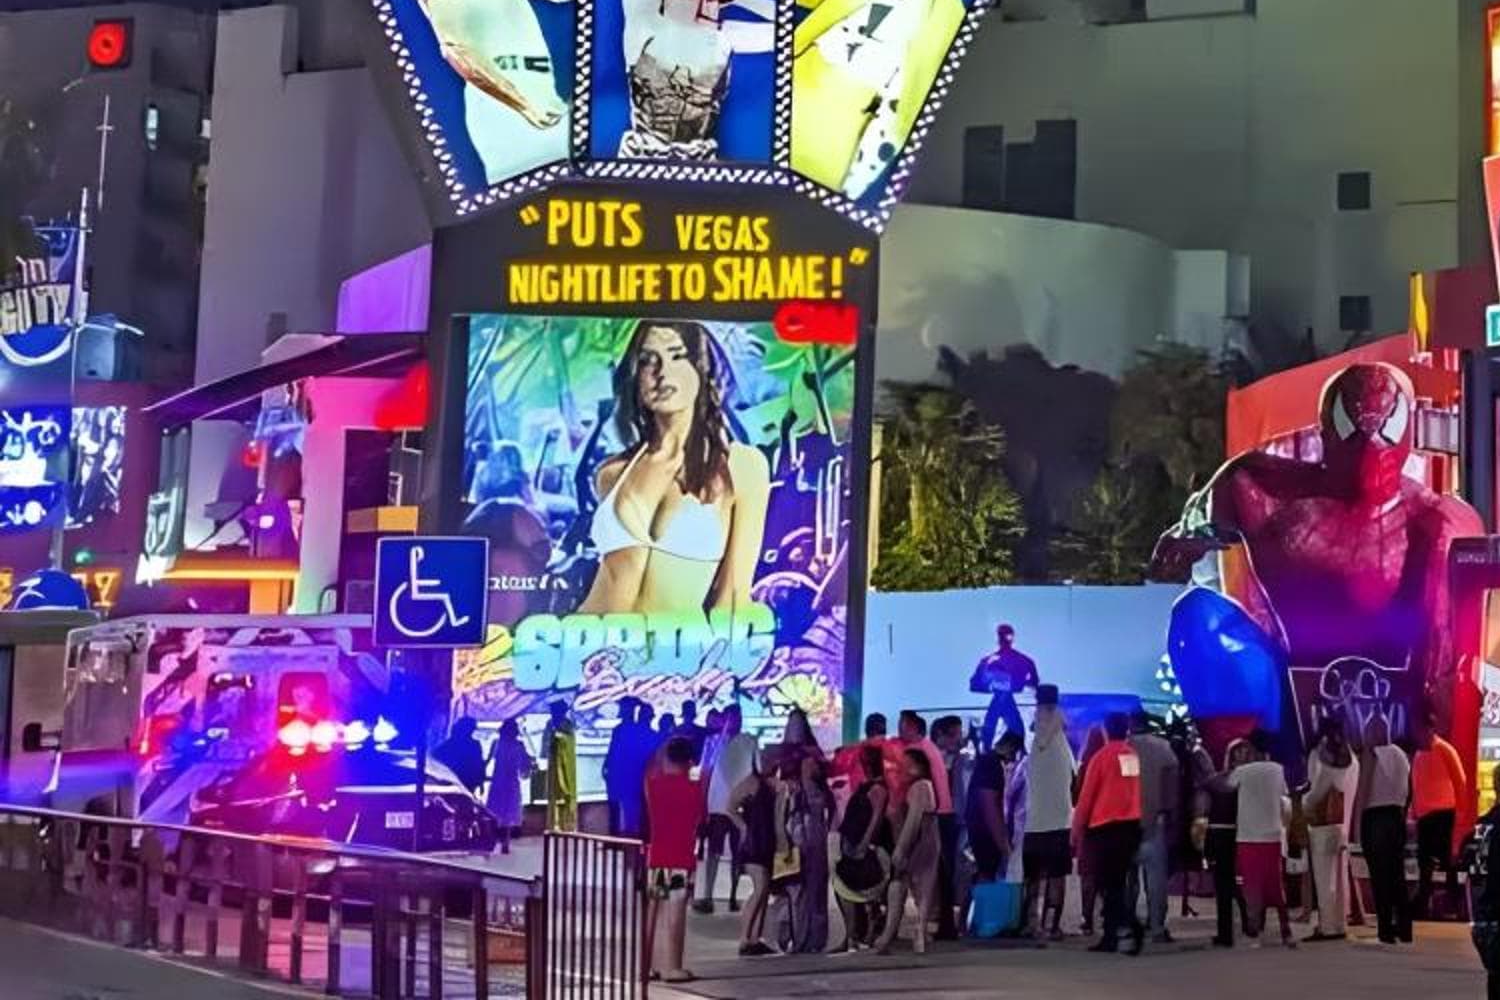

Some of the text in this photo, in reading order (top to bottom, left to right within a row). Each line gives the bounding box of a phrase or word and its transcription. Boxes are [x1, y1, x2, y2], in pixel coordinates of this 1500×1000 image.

[676, 214, 771, 253] VEGAS
[508, 263, 661, 306] NIGHTLIFE
[665, 263, 706, 302] TO
